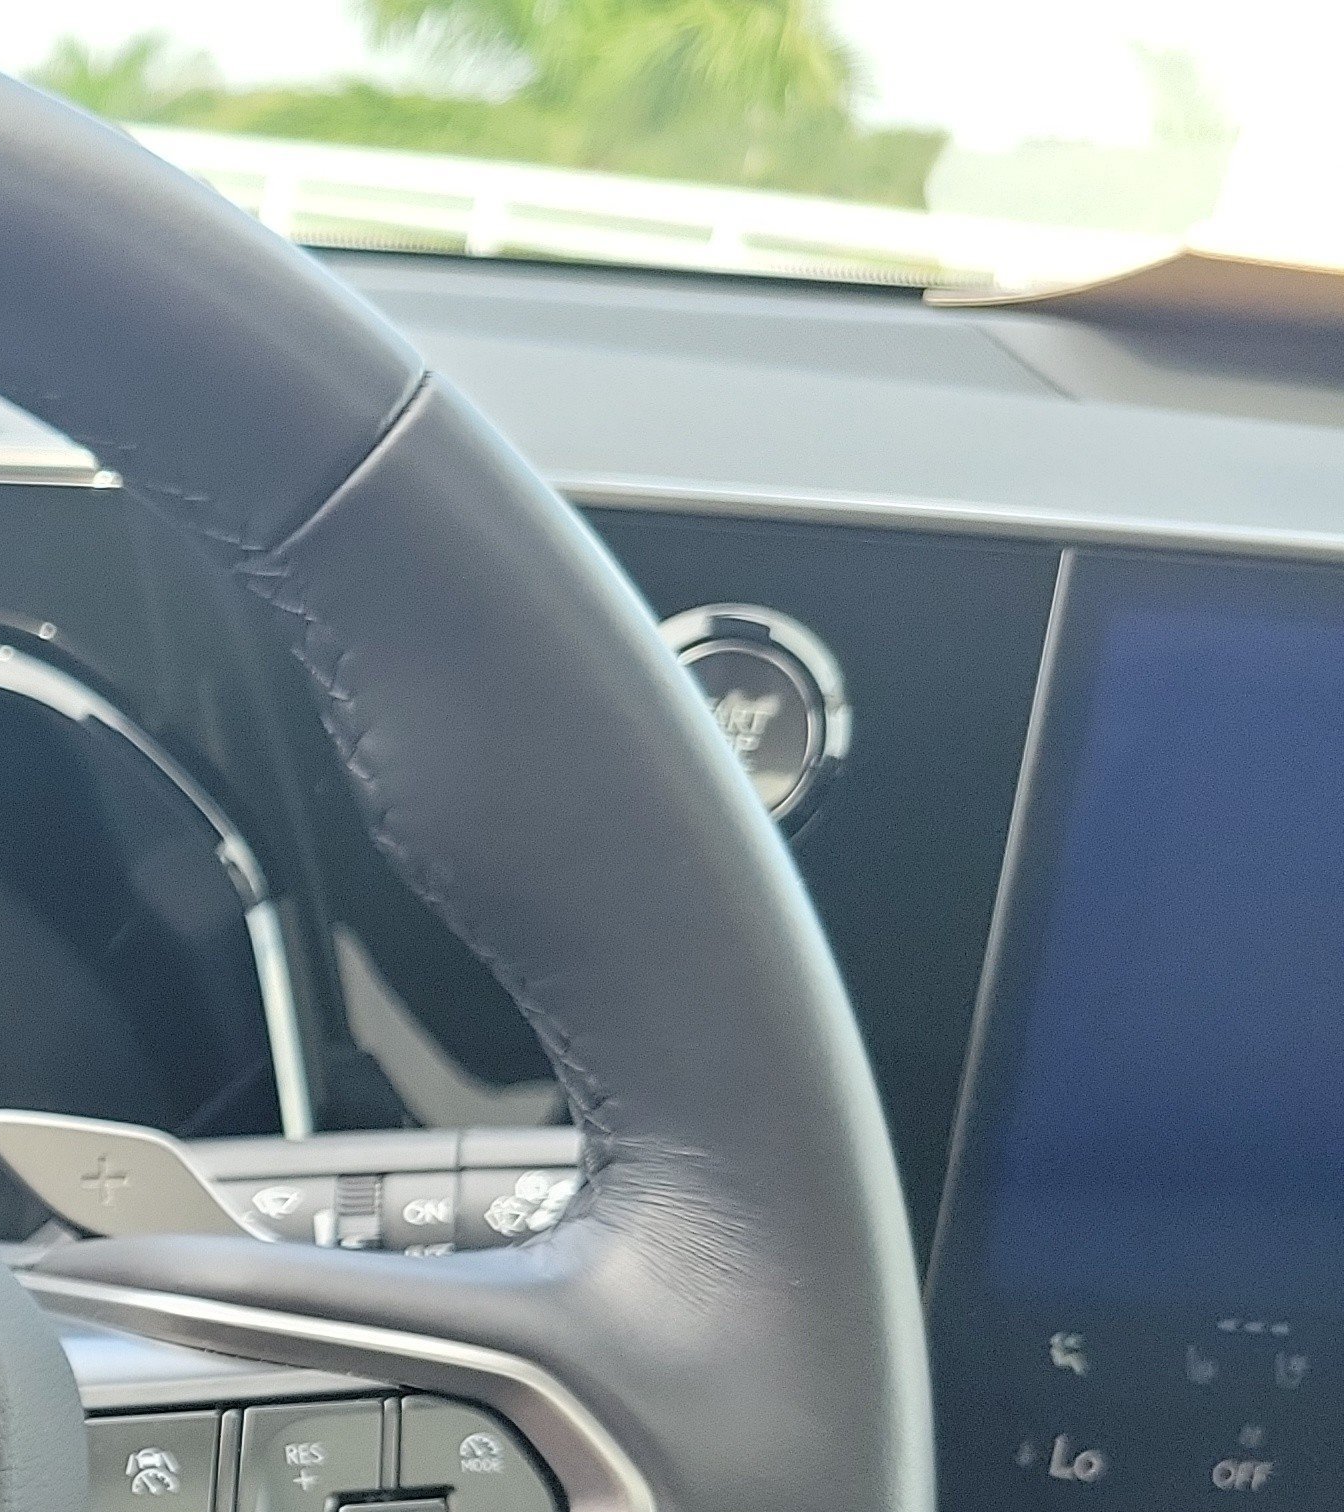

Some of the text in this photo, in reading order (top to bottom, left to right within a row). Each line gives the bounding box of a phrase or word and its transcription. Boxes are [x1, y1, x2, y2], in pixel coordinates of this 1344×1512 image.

[403, 1198, 454, 1225] ON
[285, 1442, 324, 1466] RES
[461, 1456, 504, 1473] MODE
[1212, 1457, 1273, 1492] OFF
